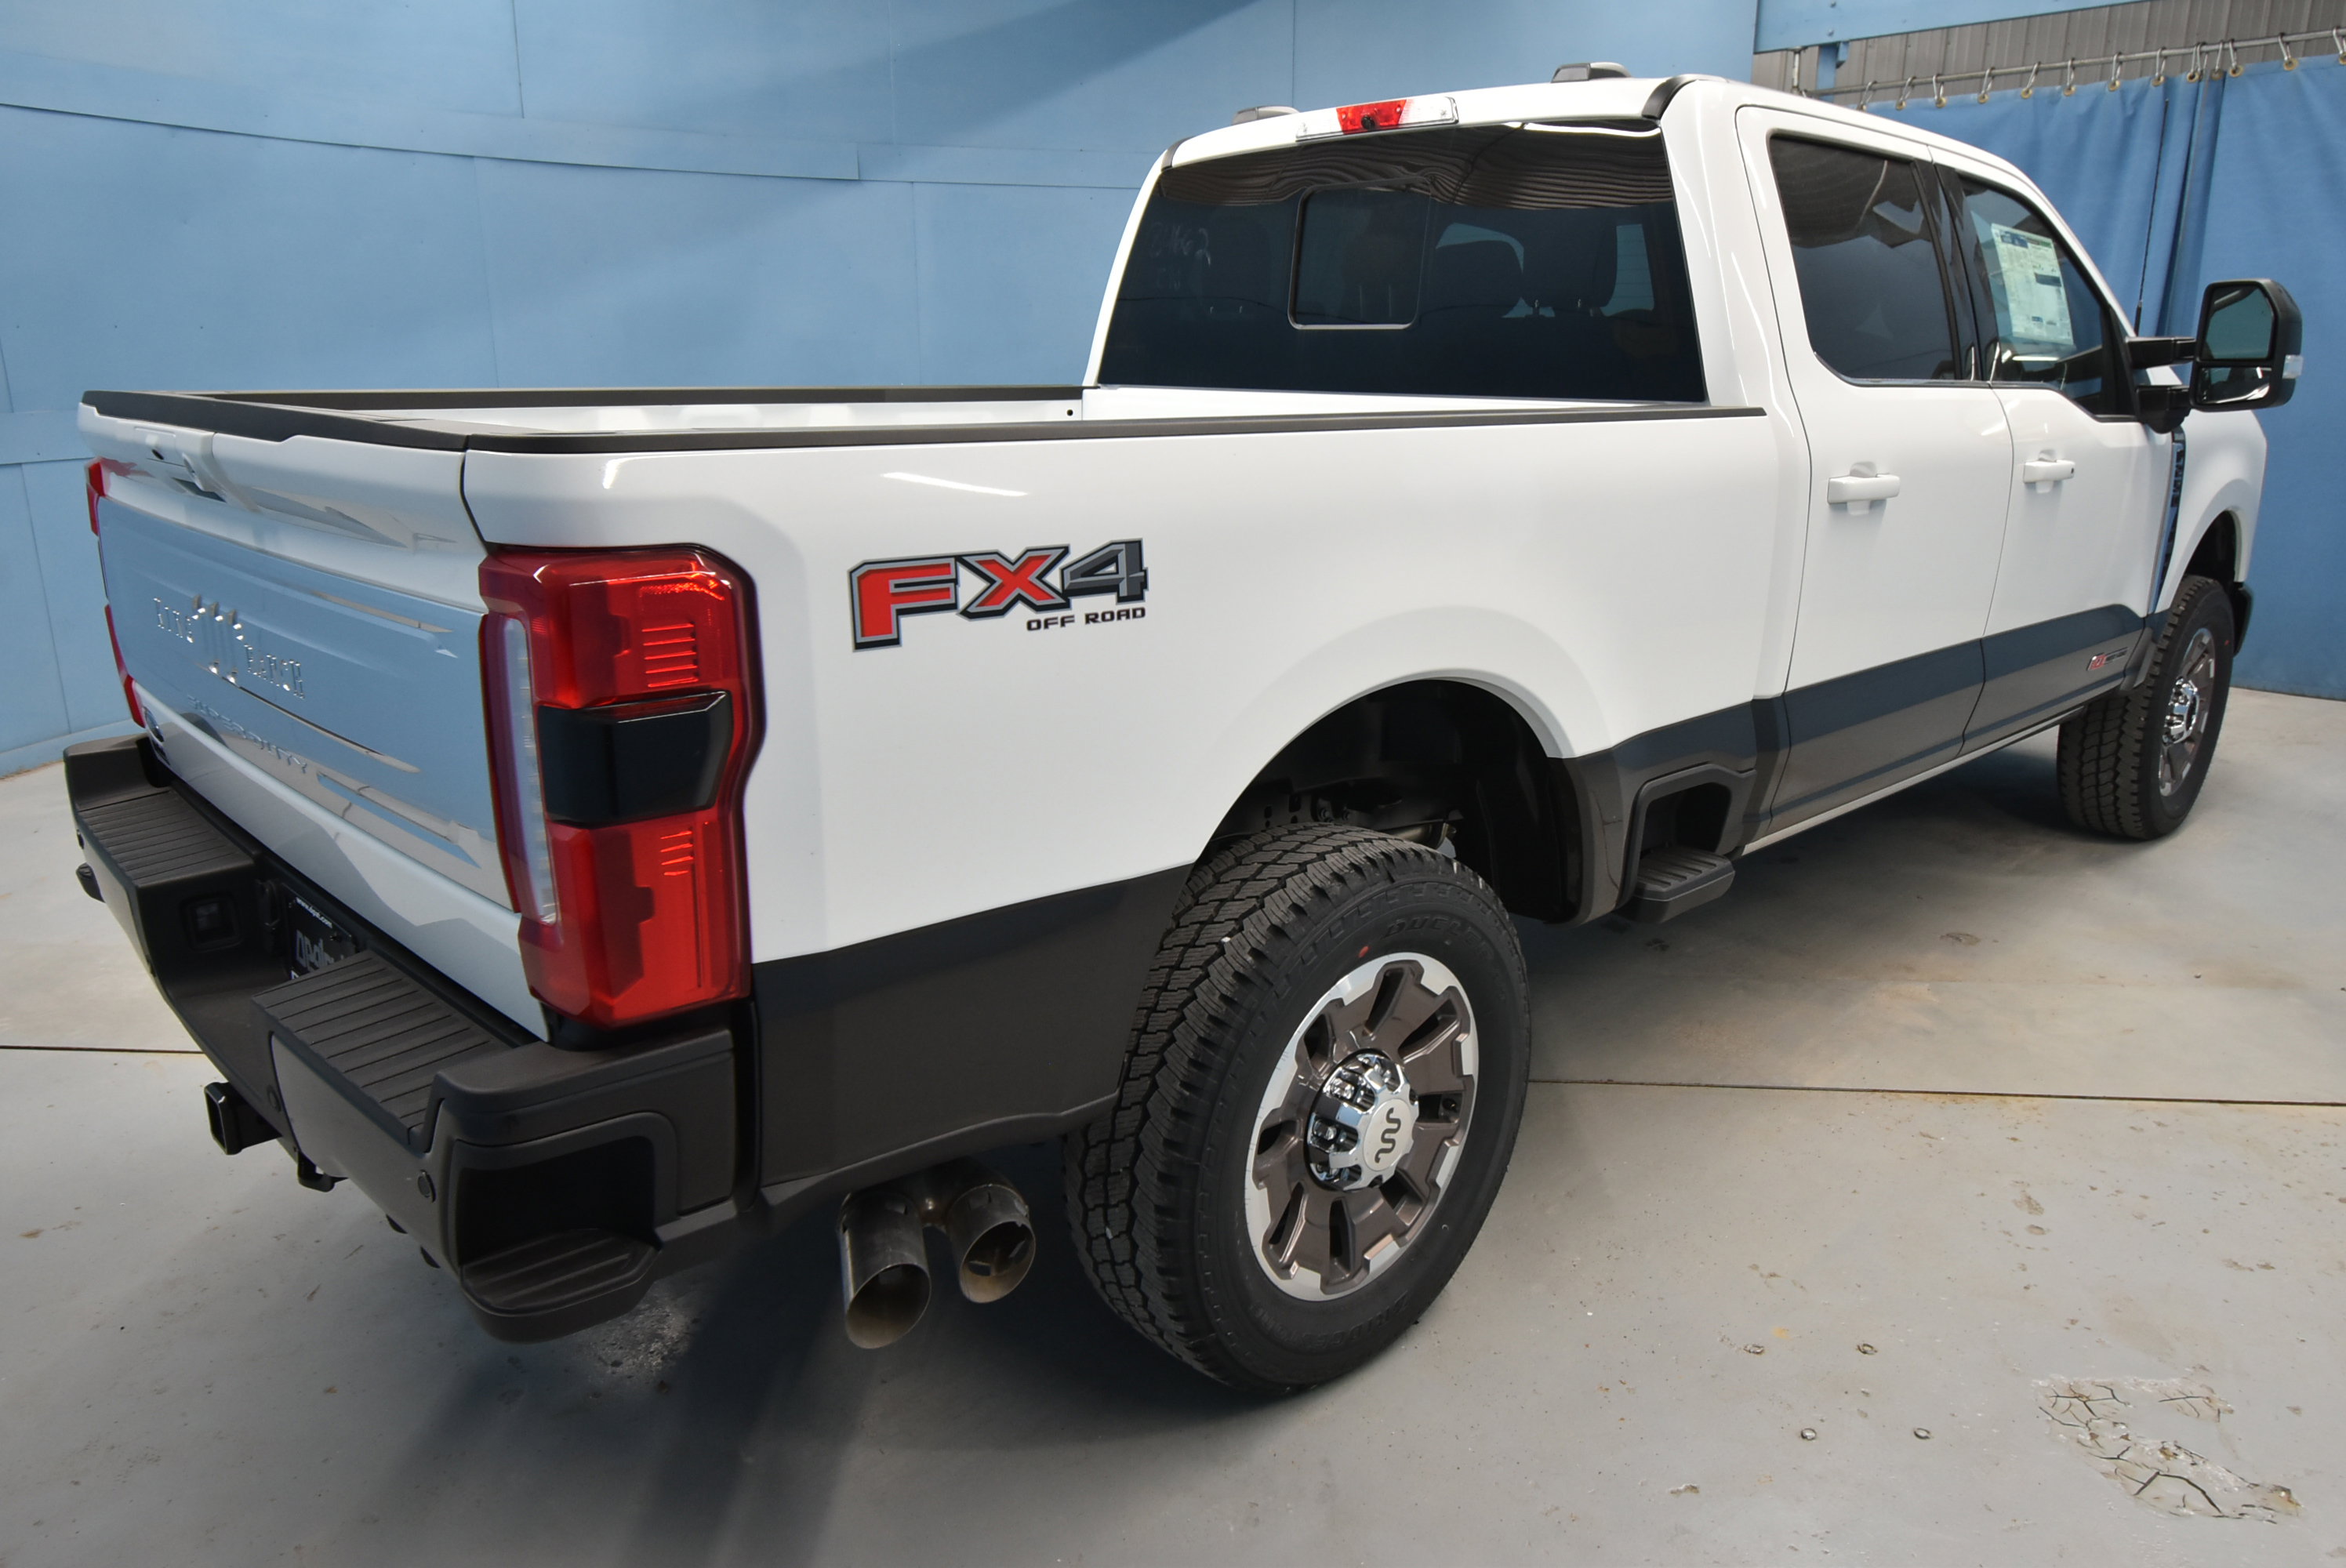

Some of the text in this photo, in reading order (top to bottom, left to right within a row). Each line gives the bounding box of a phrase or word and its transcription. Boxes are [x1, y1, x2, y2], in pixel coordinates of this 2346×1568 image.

[847, 538, 1149, 652] FX4
[1026, 607, 1146, 631] OFF ROAD
